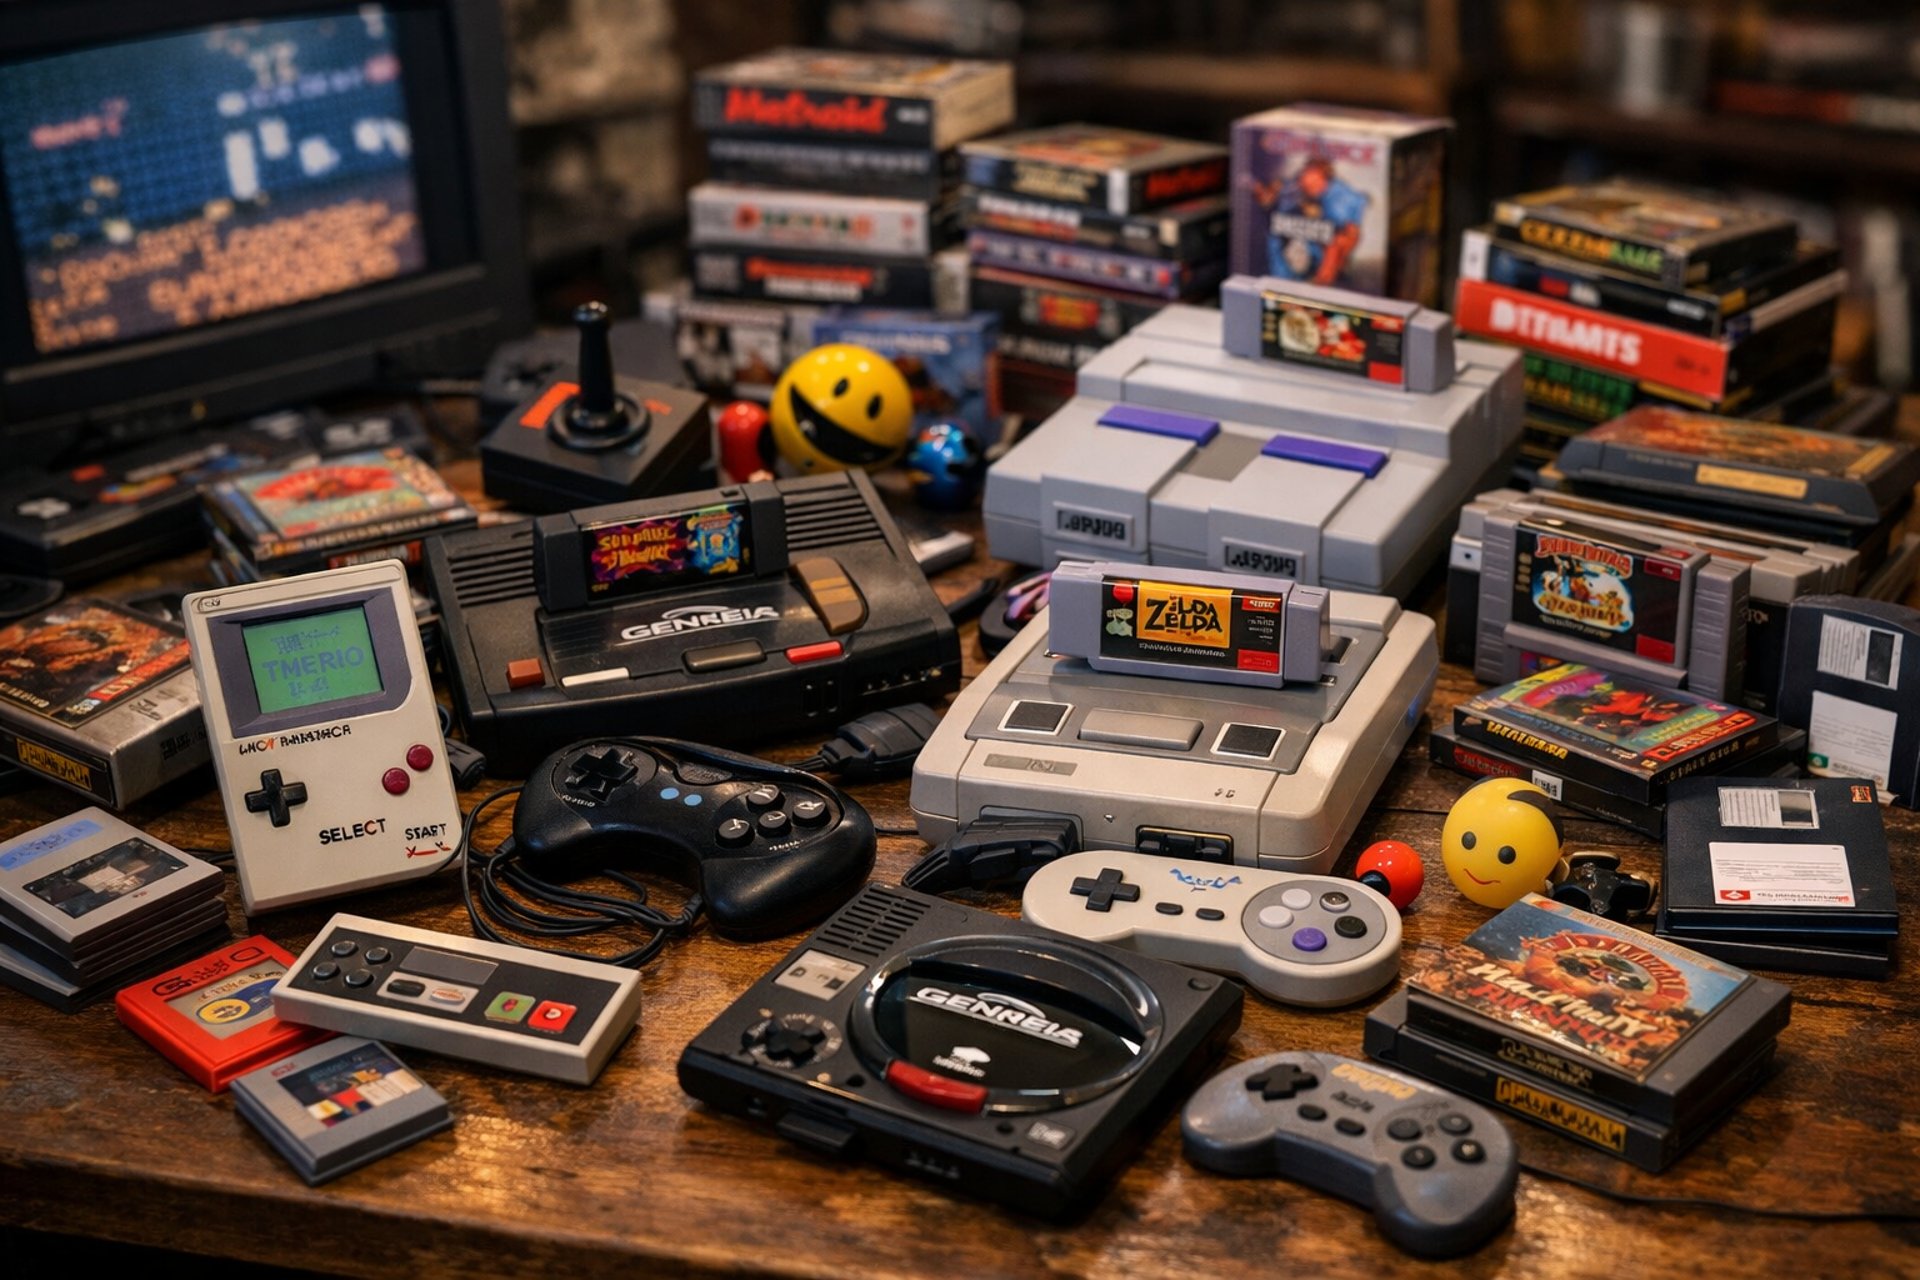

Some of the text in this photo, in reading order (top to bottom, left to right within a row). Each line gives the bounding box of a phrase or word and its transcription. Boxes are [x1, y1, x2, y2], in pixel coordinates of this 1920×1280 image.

[262, 645, 366, 683] TMERIO
[318, 818, 386, 845] SELECT
[405, 823, 447, 840] START
